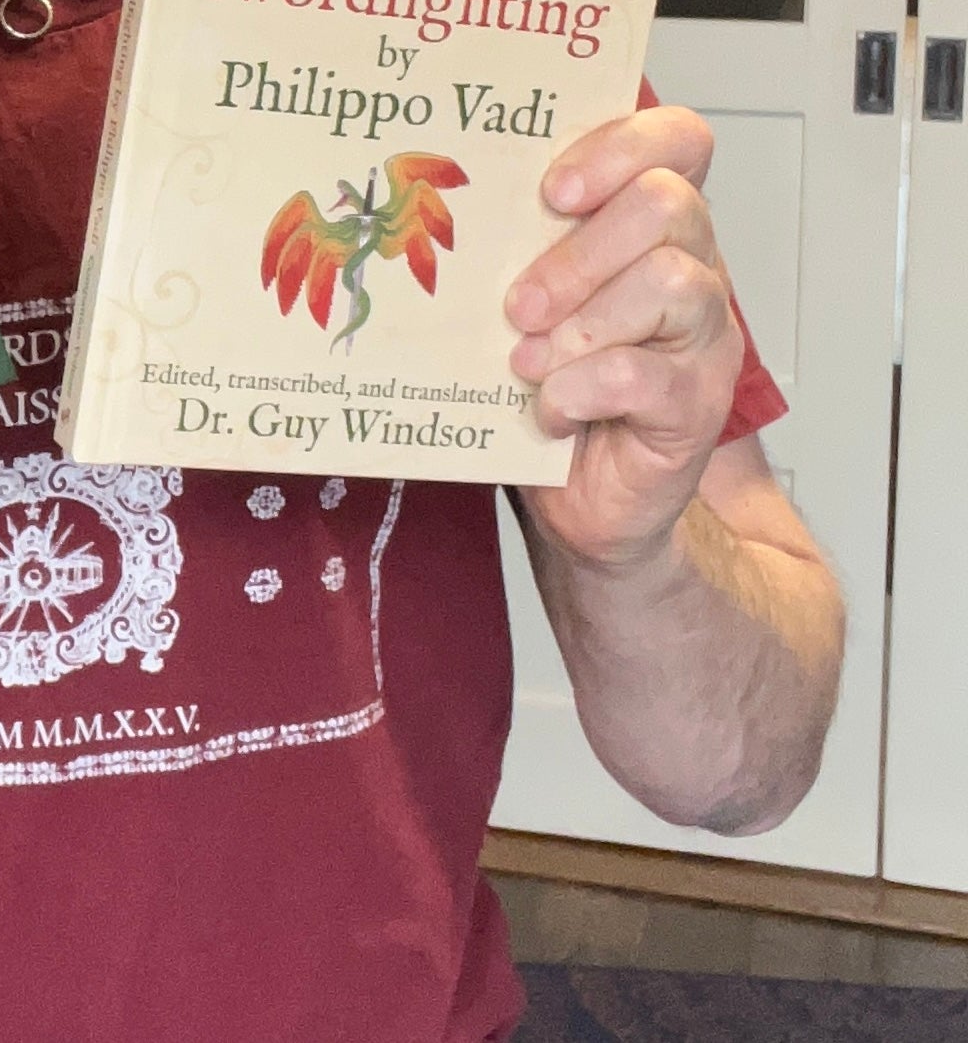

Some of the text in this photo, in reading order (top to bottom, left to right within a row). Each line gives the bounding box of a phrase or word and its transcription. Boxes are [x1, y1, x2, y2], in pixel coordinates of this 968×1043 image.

[377, 34, 421, 81] by
[215, 59, 558, 141] Philippo Vadi
[139, 363, 533, 414] Edited, transcribed, and translated by
[173, 396, 495, 452] Dr. Guy Windsor
